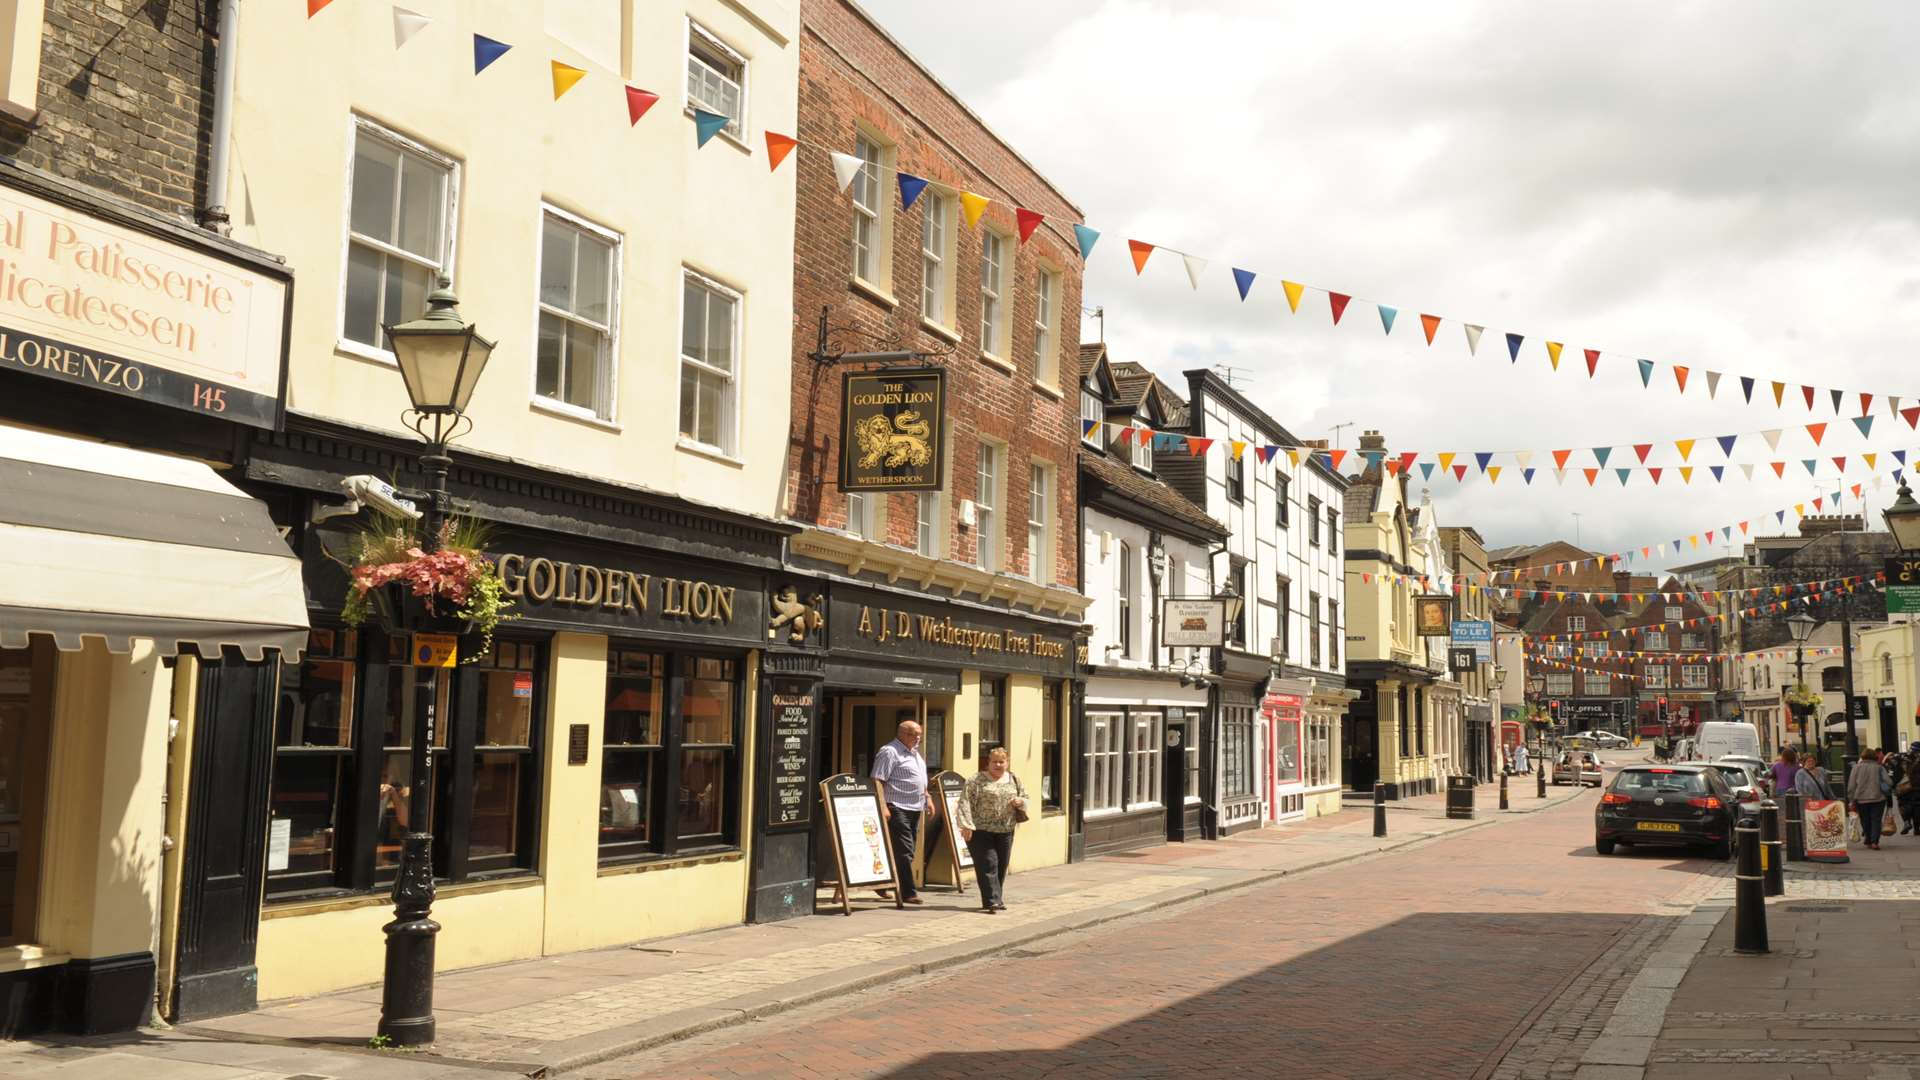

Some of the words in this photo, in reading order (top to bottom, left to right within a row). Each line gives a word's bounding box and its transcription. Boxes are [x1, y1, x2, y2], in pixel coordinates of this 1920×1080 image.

[48, 220, 233, 315] Patisserie
[0, 333, 145, 392] LORENZO
[192, 383, 227, 412] 145
[884, 383, 904, 392] THE
[854, 393, 901, 405] GOLDEN
[905, 392, 934, 403] LION
[857, 475, 924, 484] WETHERSPOON
[498, 552, 651, 611] GOLDEN
[663, 577, 737, 622] LION
[858, 605, 873, 634] A
[878, 608, 891, 643] J.
[896, 611, 913, 639] D.
[917, 614, 1002, 656] Wetherspoon
[1003, 628, 1030, 654] Free
[1032, 632, 1065, 659] House
[1454, 628, 1467, 636] TO
[1469, 628, 1488, 636] LET
[1455, 654, 1471, 667] 161
[785, 707, 802, 716] FOOD
